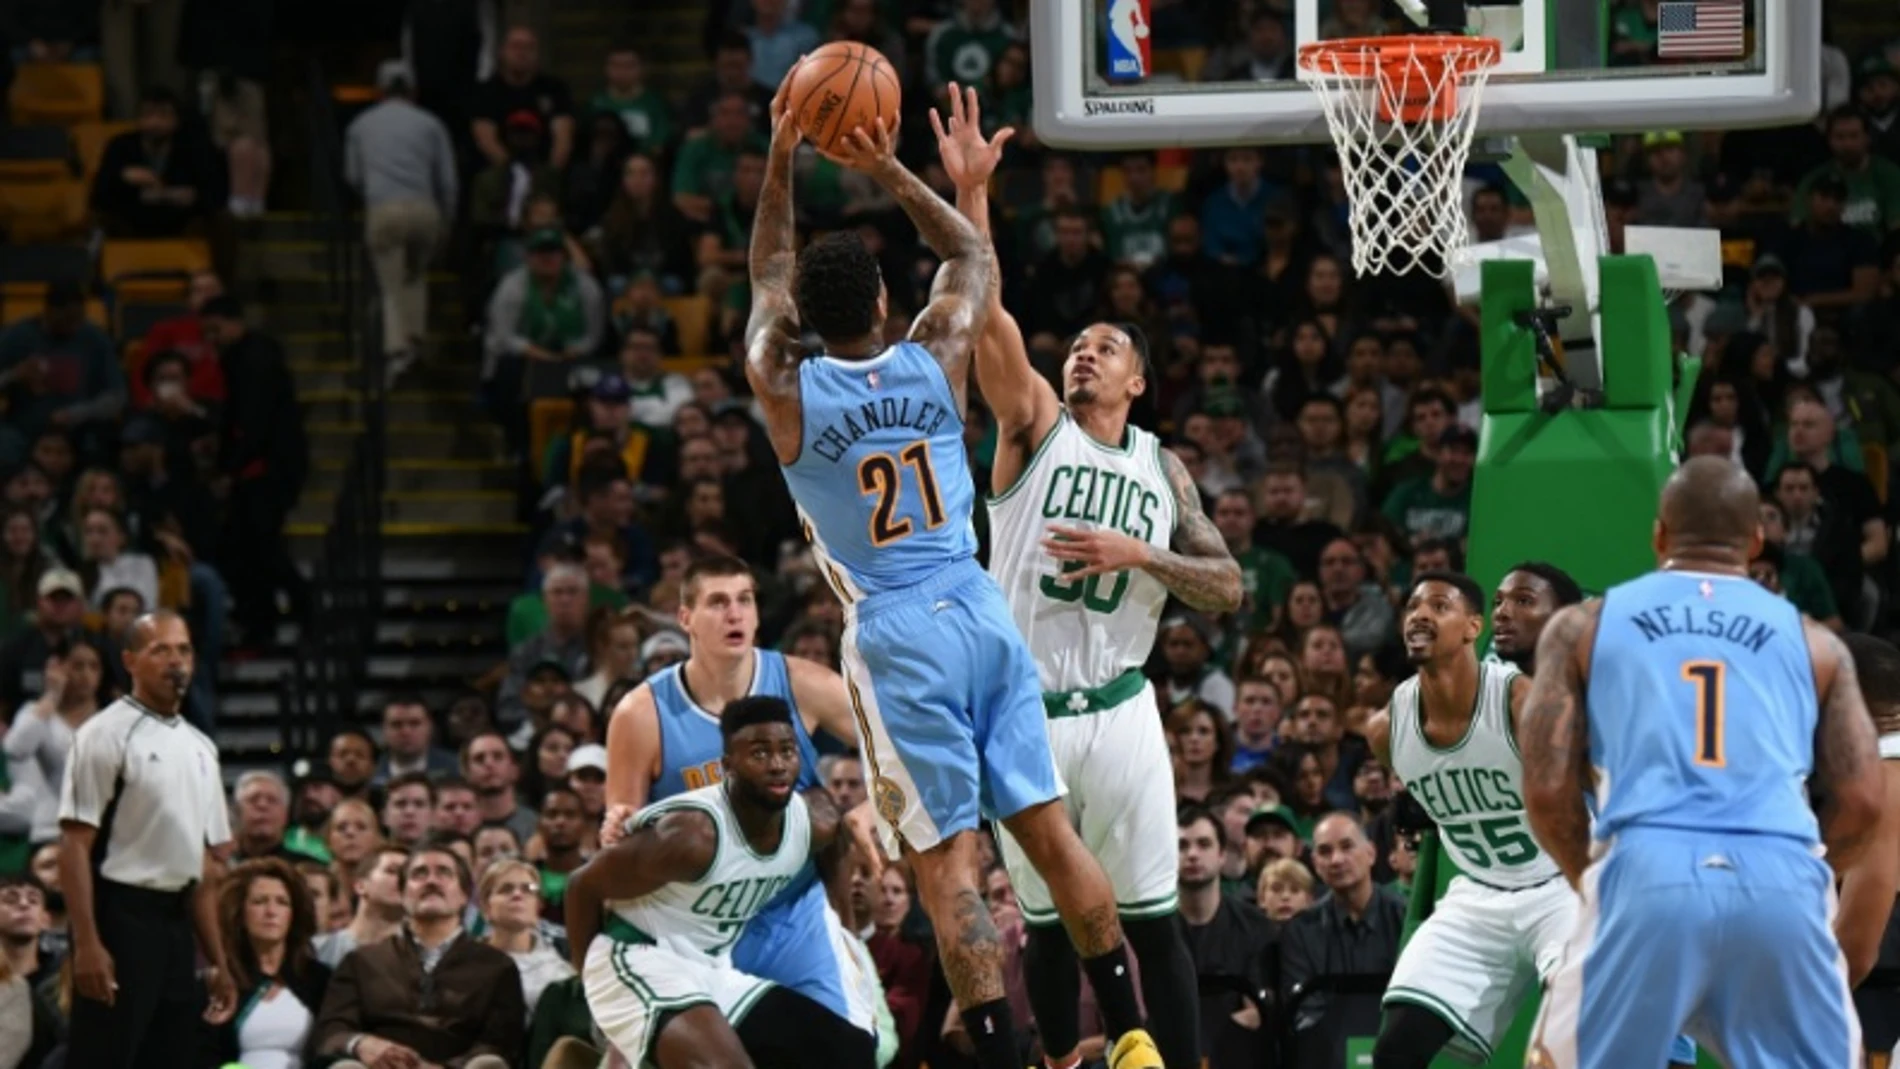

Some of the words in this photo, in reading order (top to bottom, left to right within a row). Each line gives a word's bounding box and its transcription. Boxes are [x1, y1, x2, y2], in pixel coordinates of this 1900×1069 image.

[1084, 99, 1155, 116] SPALDING
[811, 397, 947, 463] CHANDLER
[857, 438, 947, 547] 21
[1042, 464, 1158, 543] CELTICS
[1630, 606, 1776, 654] NELSON
[1681, 661, 1726, 769] 1
[1406, 767, 1524, 818] CELTICS
[1442, 815, 1539, 869] 55
